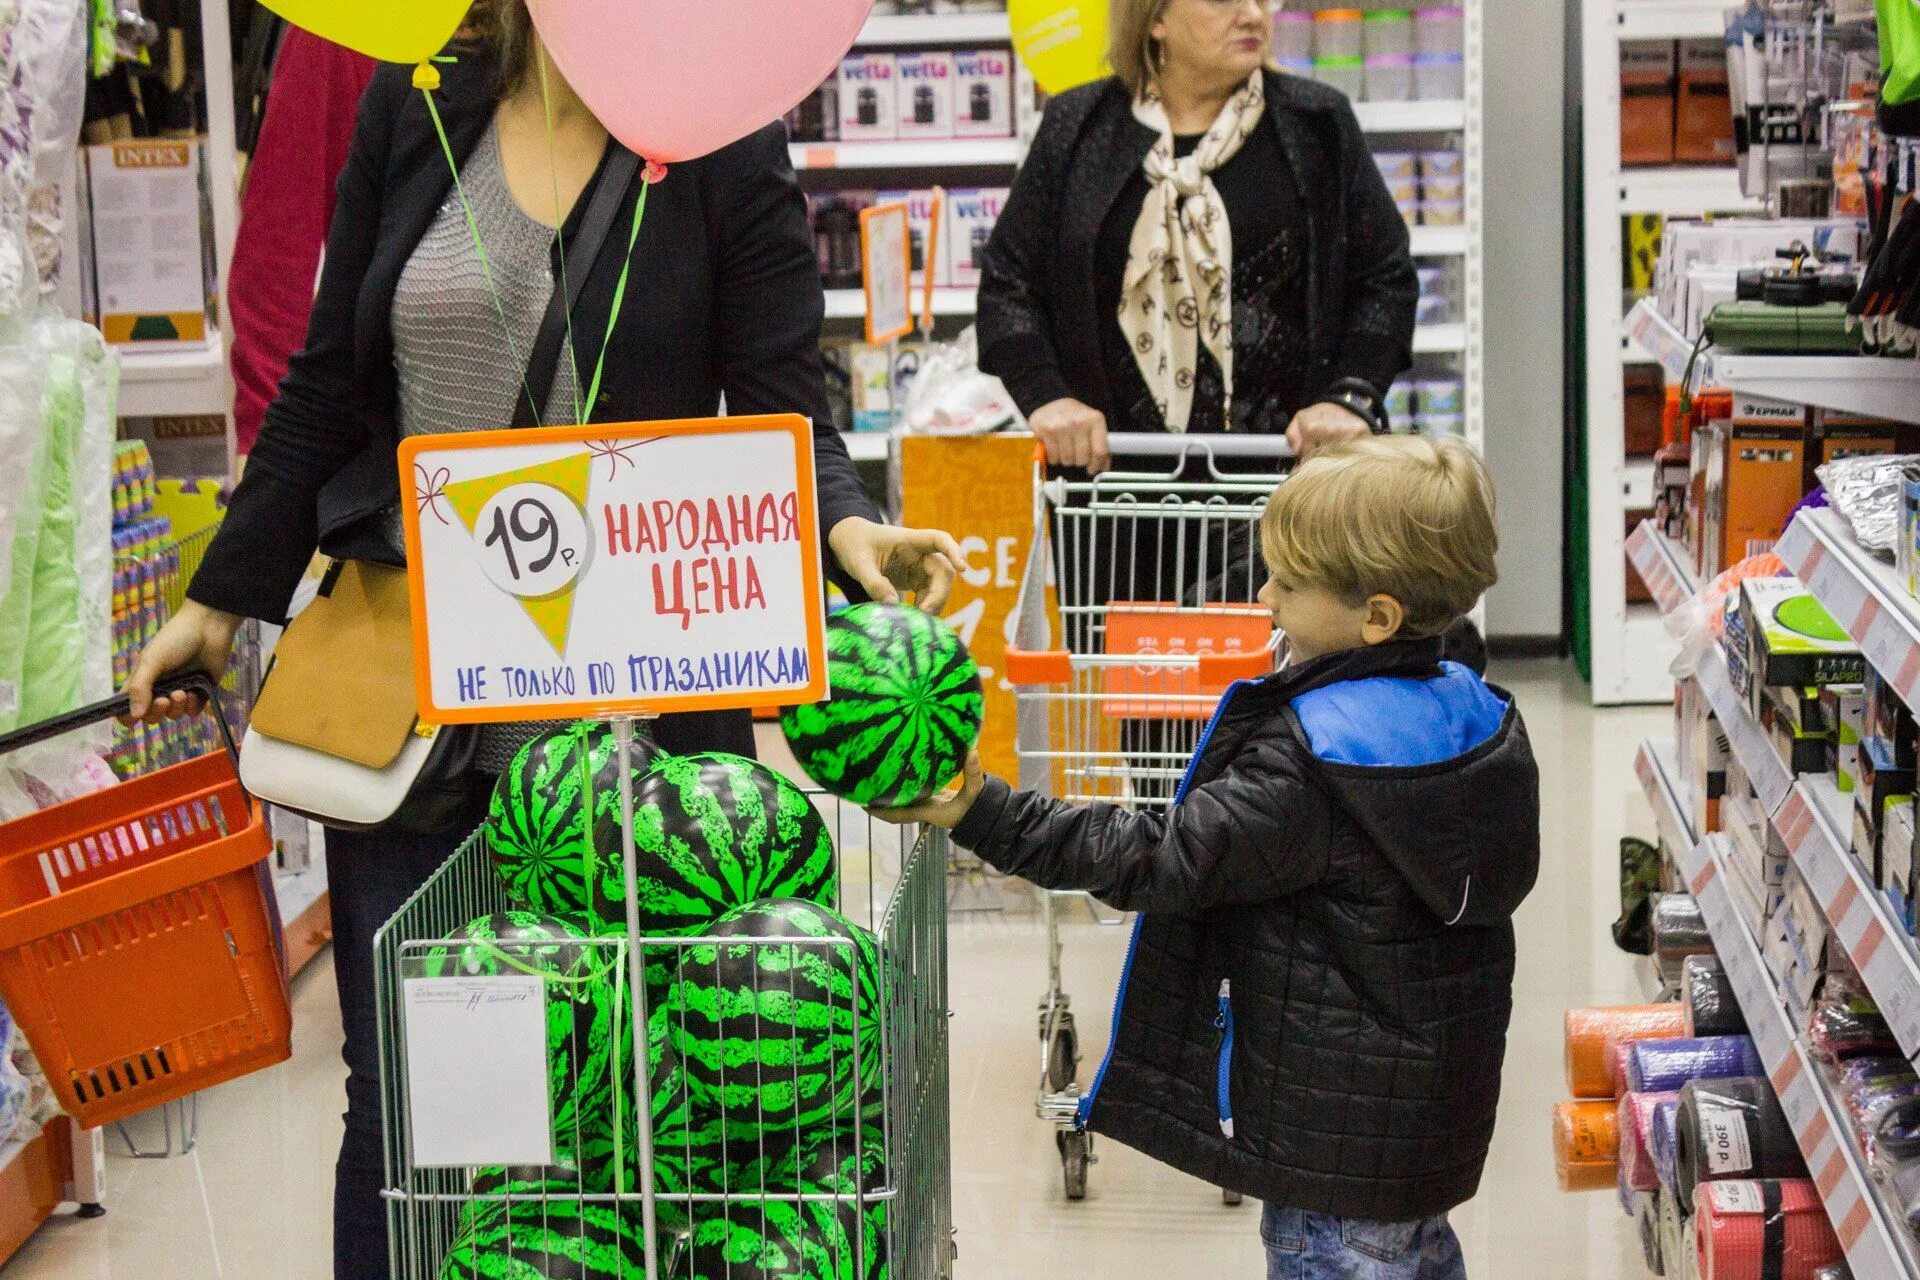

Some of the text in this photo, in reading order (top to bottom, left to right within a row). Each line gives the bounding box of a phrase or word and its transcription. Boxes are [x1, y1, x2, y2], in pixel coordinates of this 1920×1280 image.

[118, 147, 182, 166] INTEX
[485, 498, 559, 580] 19
[604, 491, 800, 556] НАРОДНАЯ
[652, 555, 767, 630] ЦЕНА
[457, 646, 810, 702] НЕ ТОЛЬКО ПО ПРАЗДНИКАМ
[1714, 1123, 1730, 1149] 390
